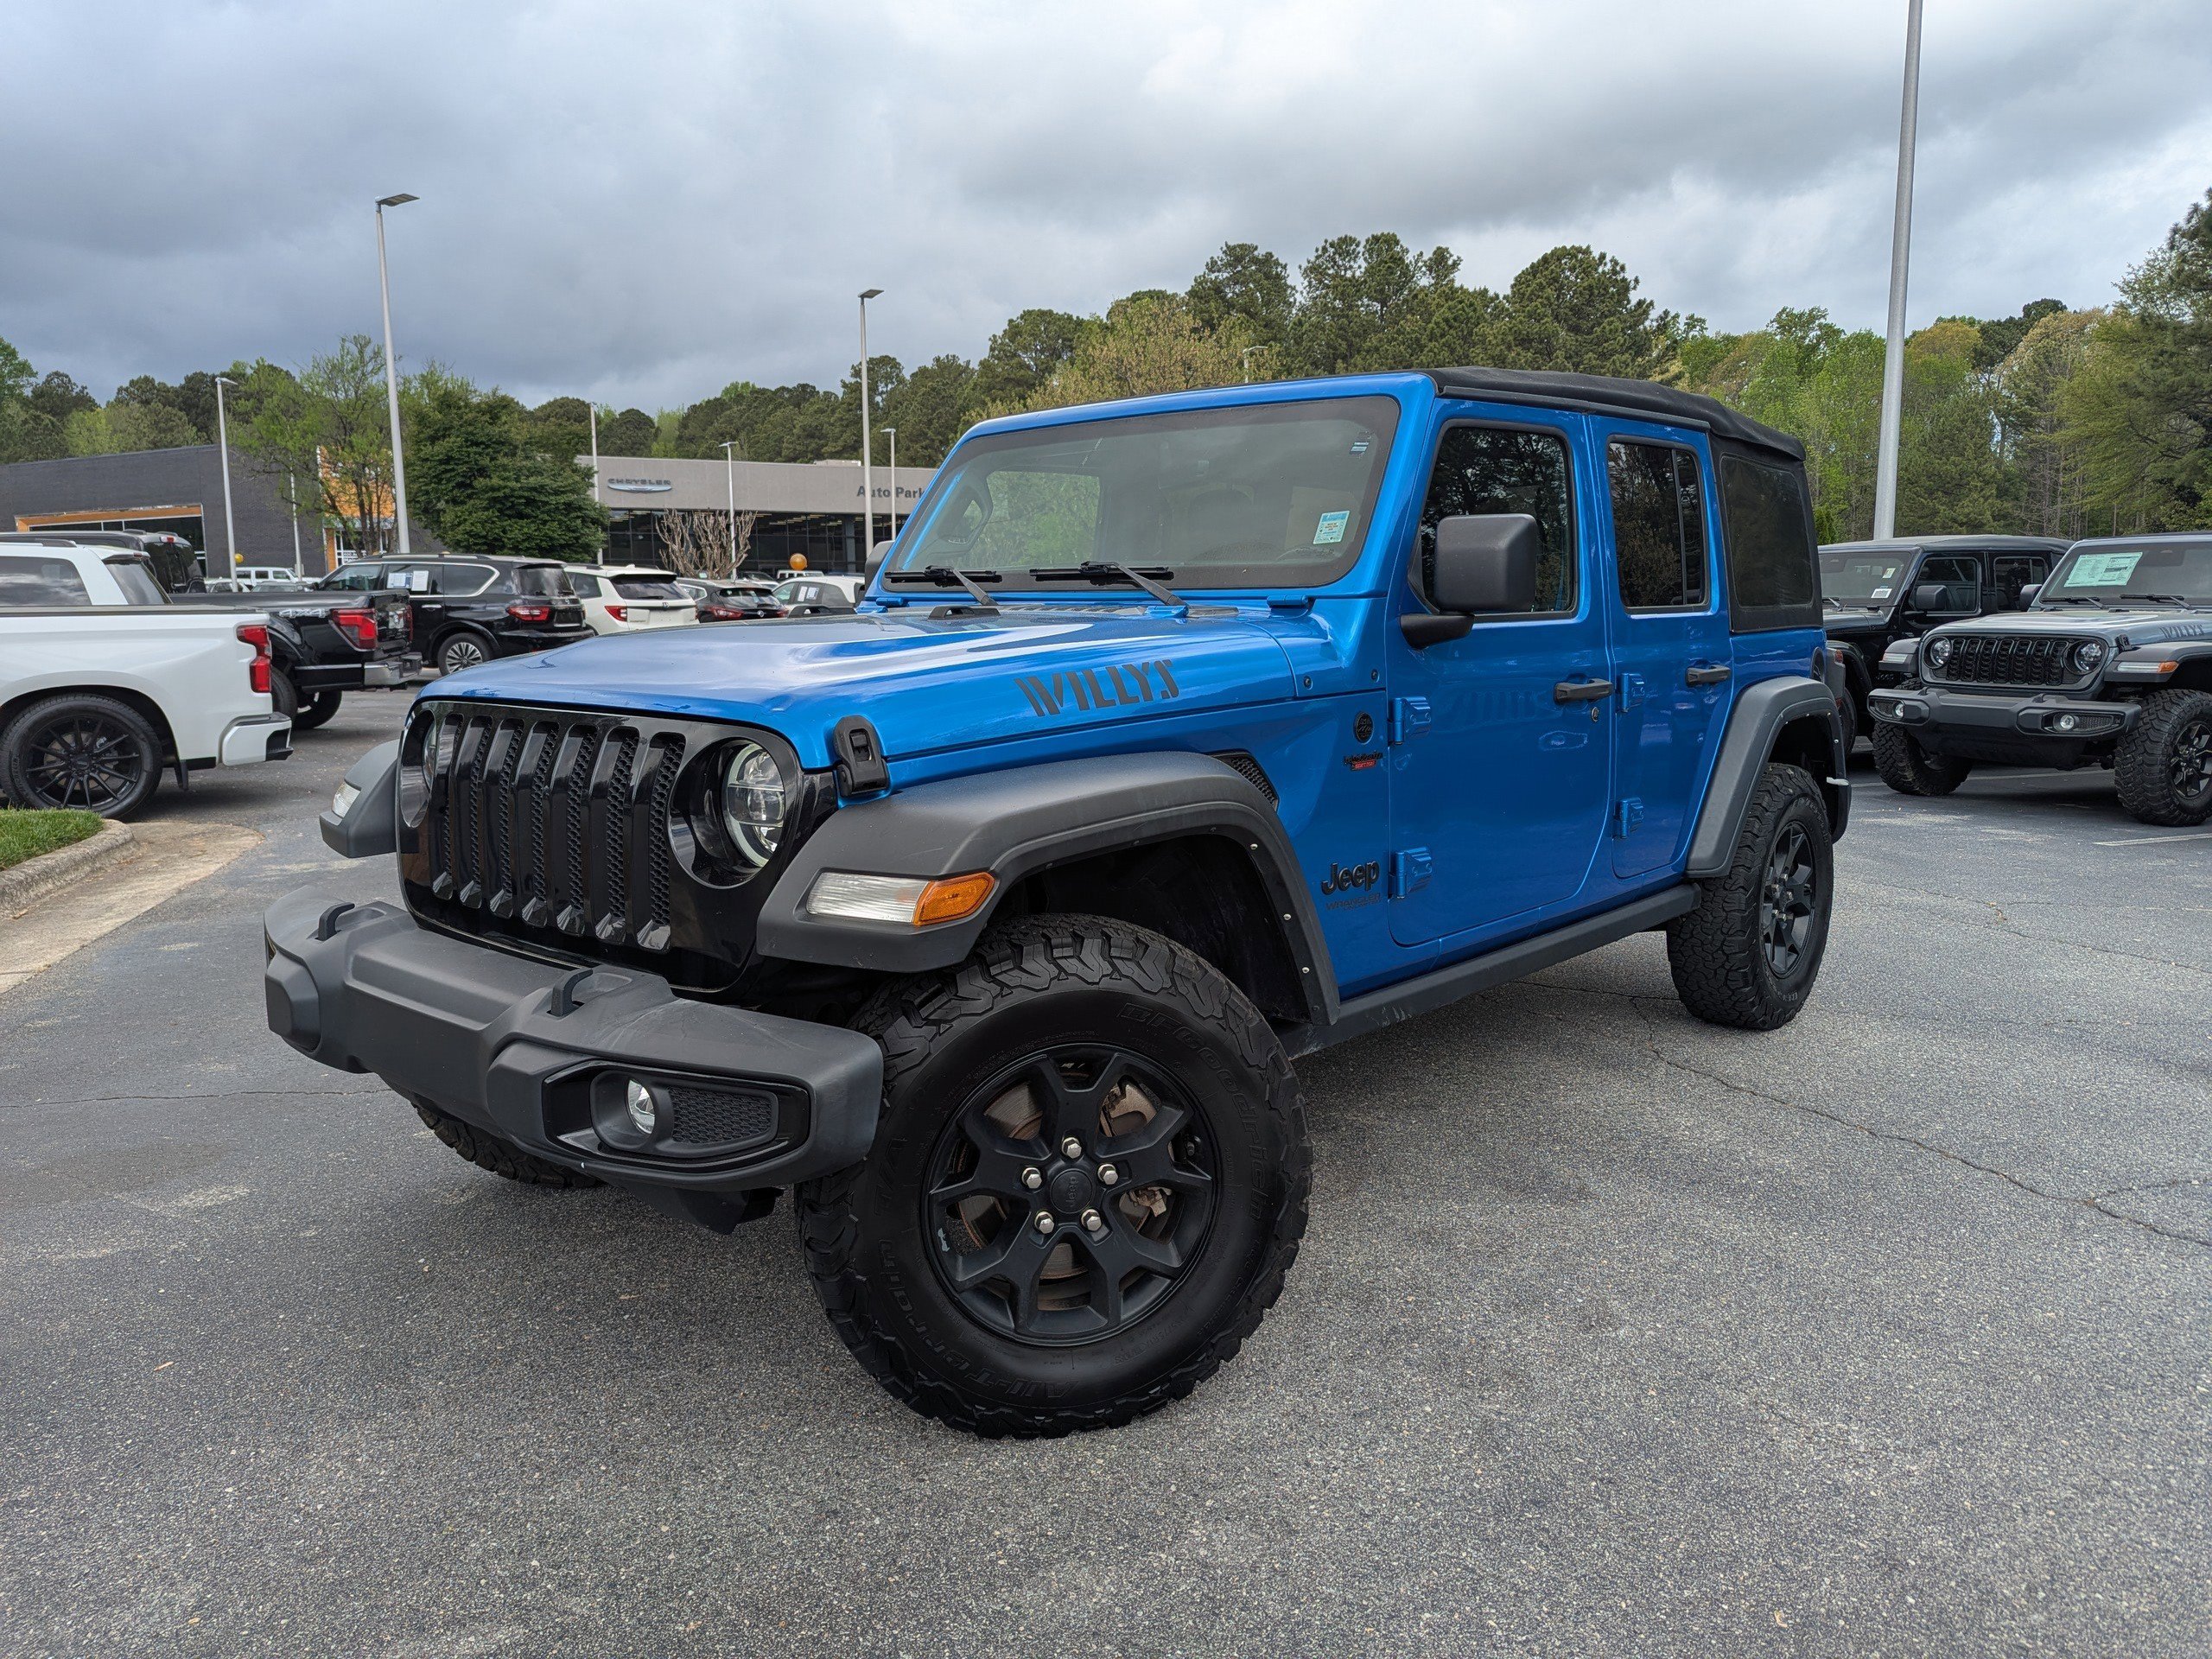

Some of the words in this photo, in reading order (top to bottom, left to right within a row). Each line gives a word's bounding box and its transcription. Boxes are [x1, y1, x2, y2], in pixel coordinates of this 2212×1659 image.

[1014, 659, 1179, 716] WILLYS
[1321, 861, 1379, 895] Jeep
[1116, 1002, 1268, 1219] BFGoodrich
